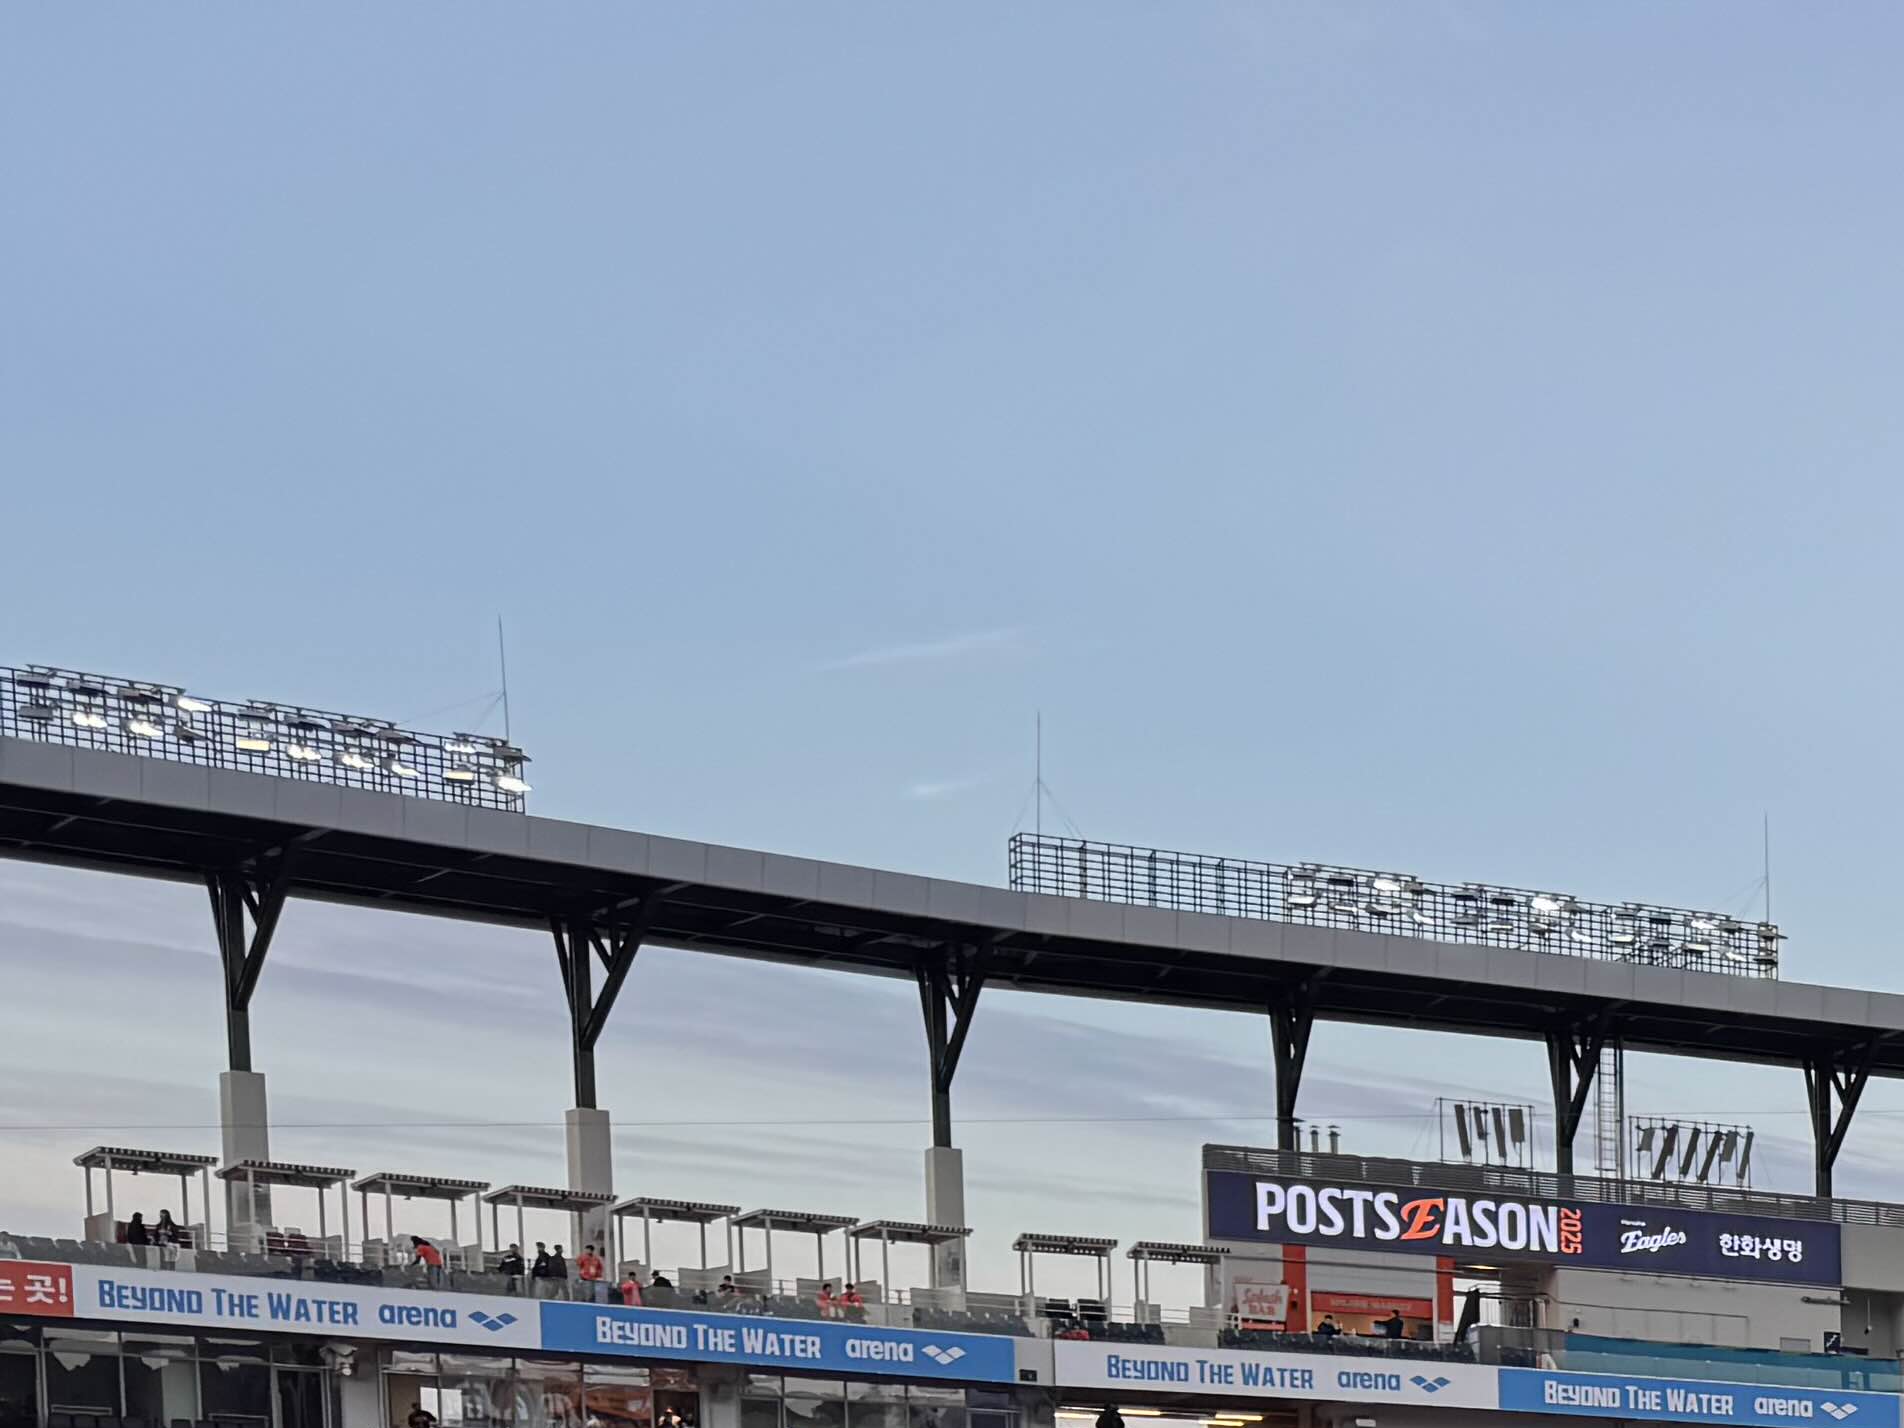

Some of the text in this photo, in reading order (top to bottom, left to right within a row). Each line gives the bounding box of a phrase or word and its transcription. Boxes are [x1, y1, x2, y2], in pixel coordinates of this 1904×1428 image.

[1257, 1182, 1804, 1264] POSTSEASON 2025 Eagles 한화생명
[24, 1276, 67, 1304] 곳!
[379, 1304, 457, 1328] arena
[845, 1338, 914, 1362] arena
[1337, 1370, 1401, 1392] arena
[1754, 1396, 1813, 1418] arena
